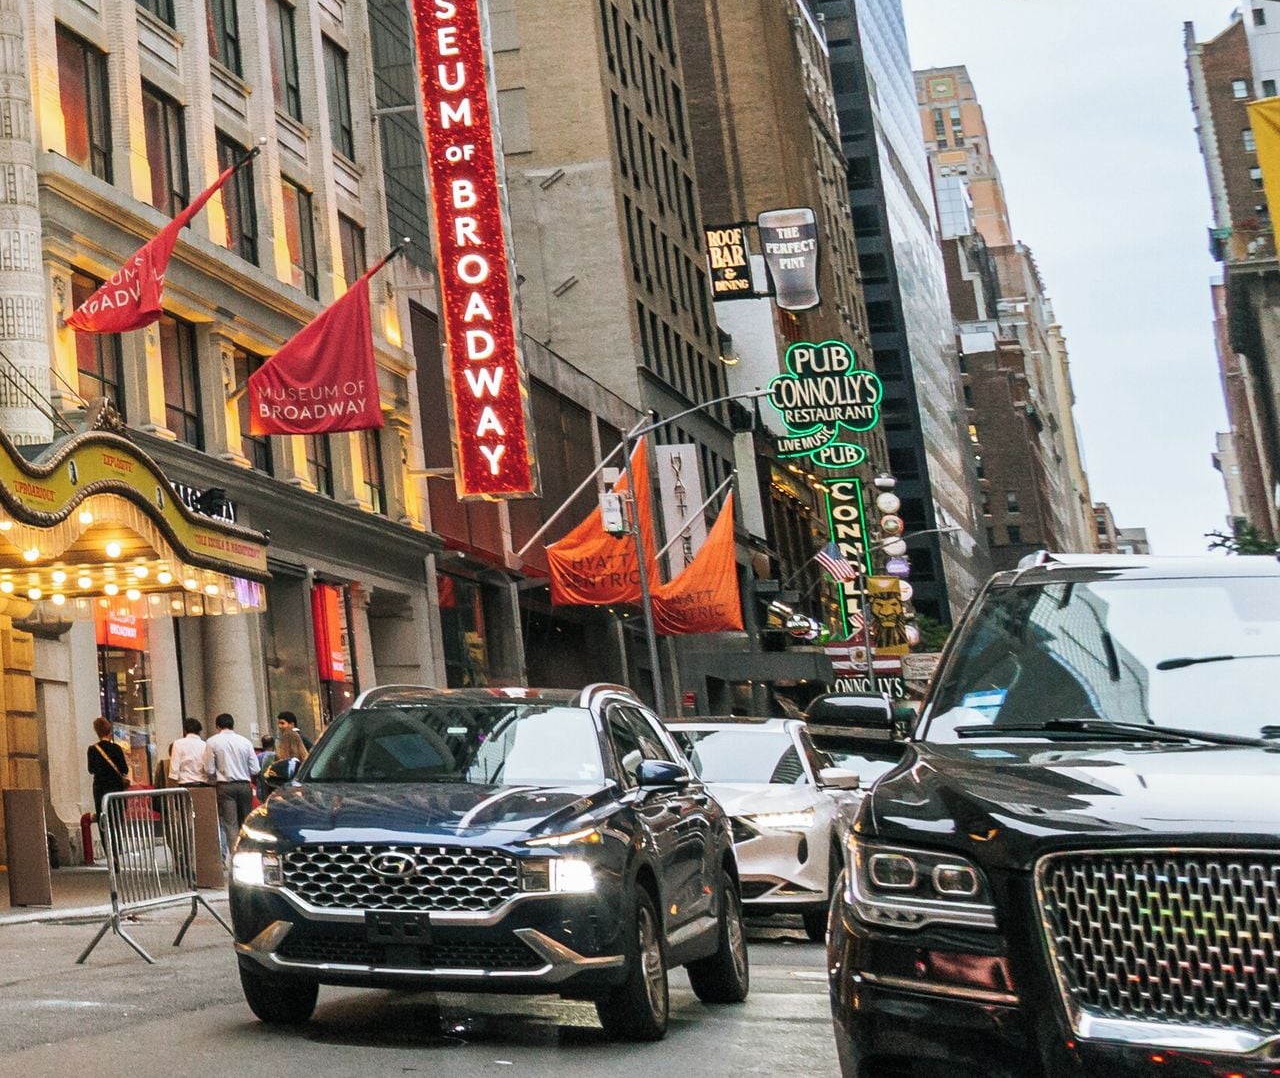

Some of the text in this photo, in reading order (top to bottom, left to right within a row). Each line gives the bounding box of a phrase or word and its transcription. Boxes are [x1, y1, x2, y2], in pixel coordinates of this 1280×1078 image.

[445, 144, 475, 162] OF
[706, 228, 742, 248] ROOF
[776, 227, 800, 239] THE
[765, 240, 815, 254] PERFECT
[709, 246, 746, 269] BAR
[779, 257, 806, 270] PINT
[724, 268, 737, 279] &
[715, 279, 749, 292] DINING
[452, 179, 506, 475] BROADWAY
[793, 346, 850, 373] PUB
[257, 380, 367, 401] MUSEUM OF
[770, 374, 878, 408] CONNOLLY'S
[259, 398, 367, 420] BROADWAY
[785, 404, 874, 423] RESTAURANT
[777, 426, 836, 452] LIVE MUSIC
[819, 447, 859, 464] PUB
